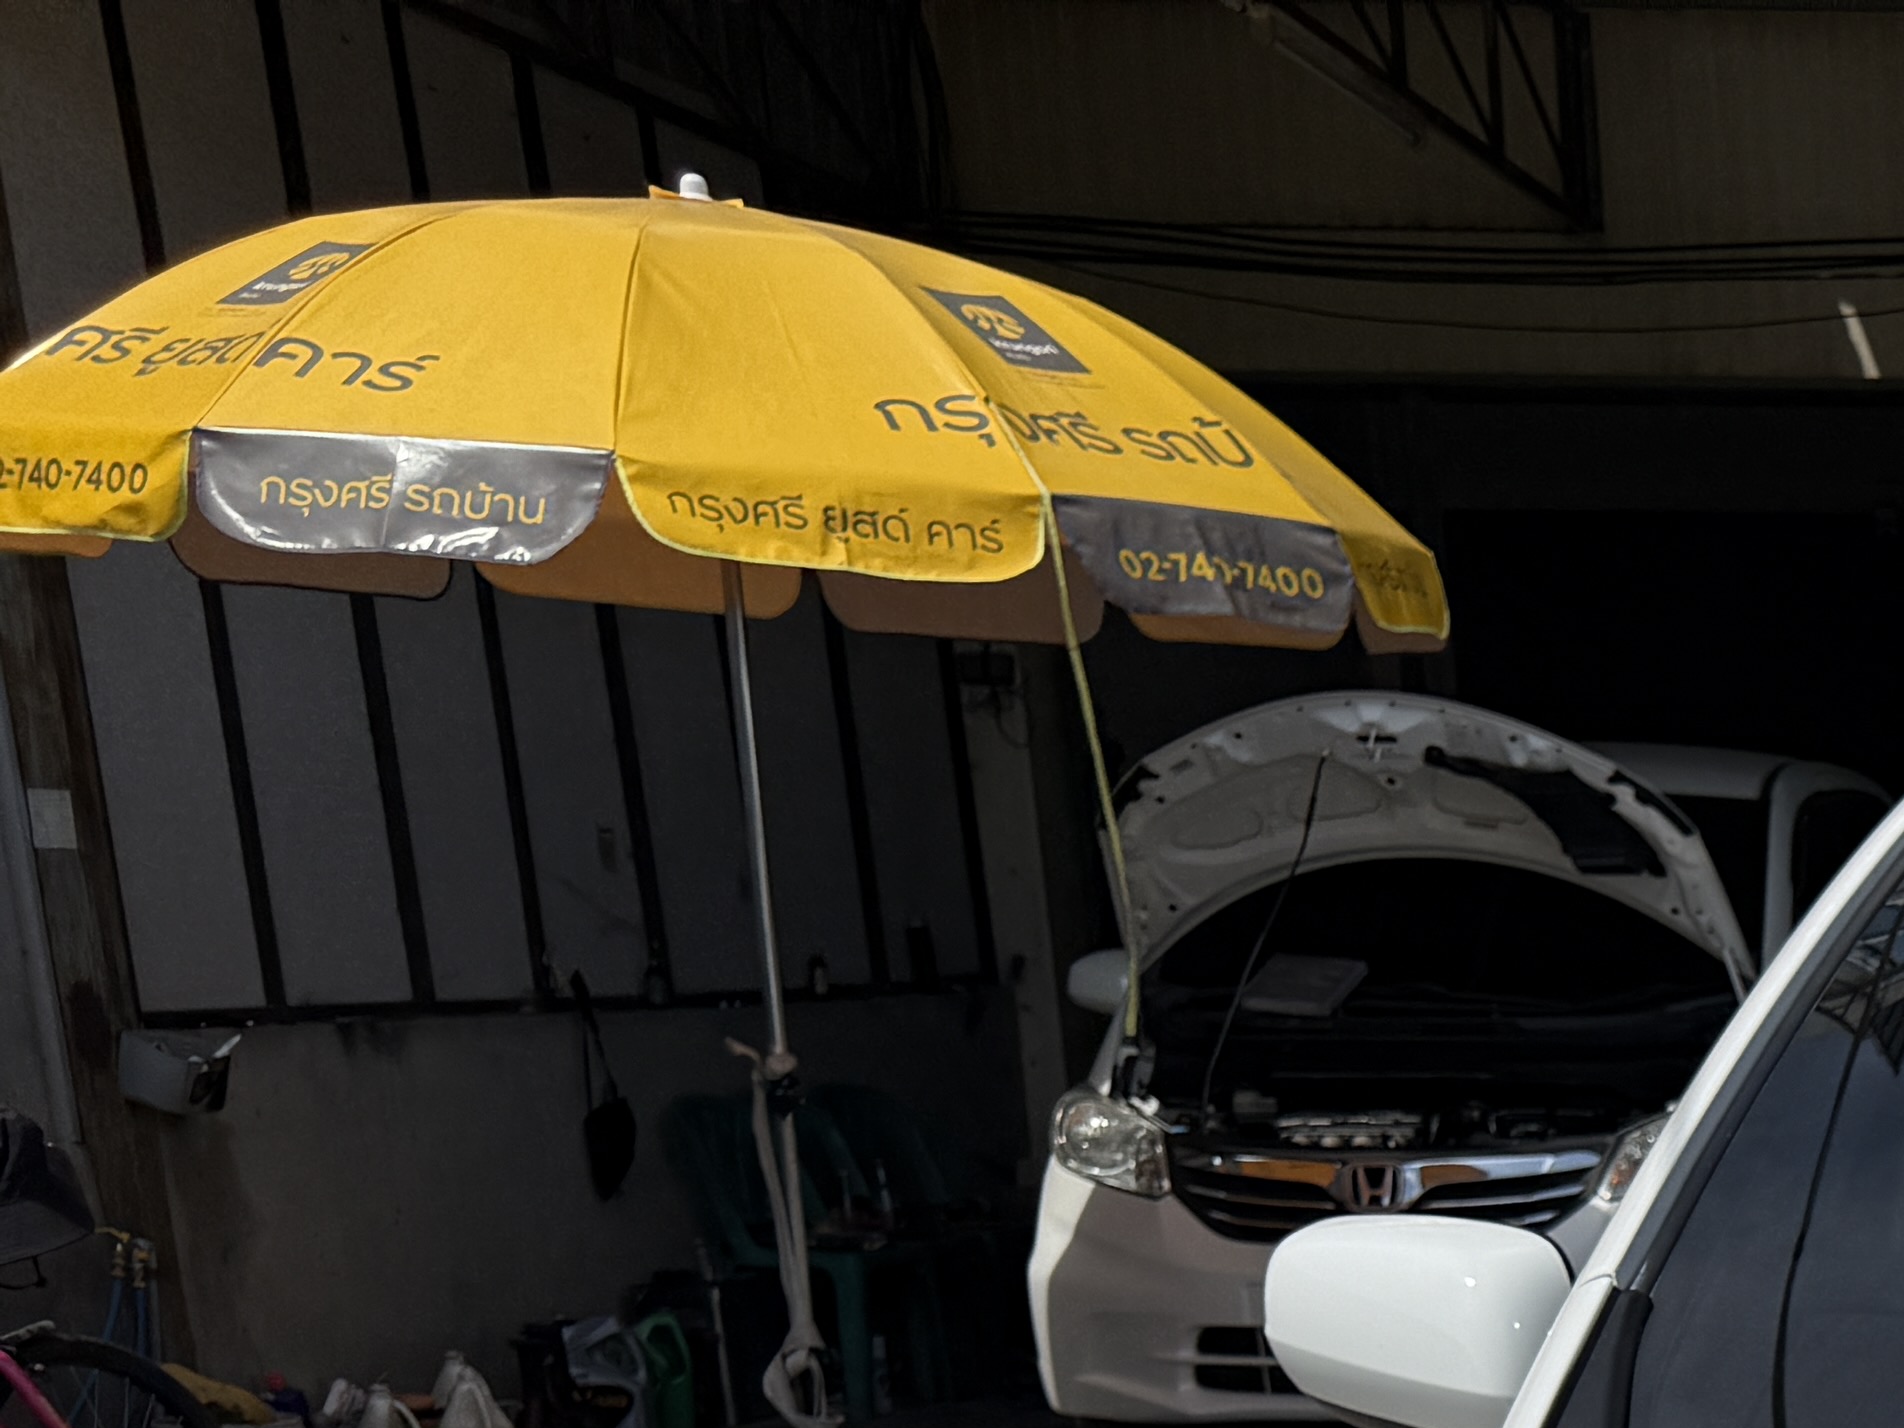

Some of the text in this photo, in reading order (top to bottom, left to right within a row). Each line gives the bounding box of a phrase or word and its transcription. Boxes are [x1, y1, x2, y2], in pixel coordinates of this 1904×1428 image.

[253, 336, 440, 392] คาร์
[259, 472, 547, 525] กรุงศรี รถบ้าน
[666, 490, 809, 534] กรุงศรี
[926, 518, 1005, 554] คาร์
